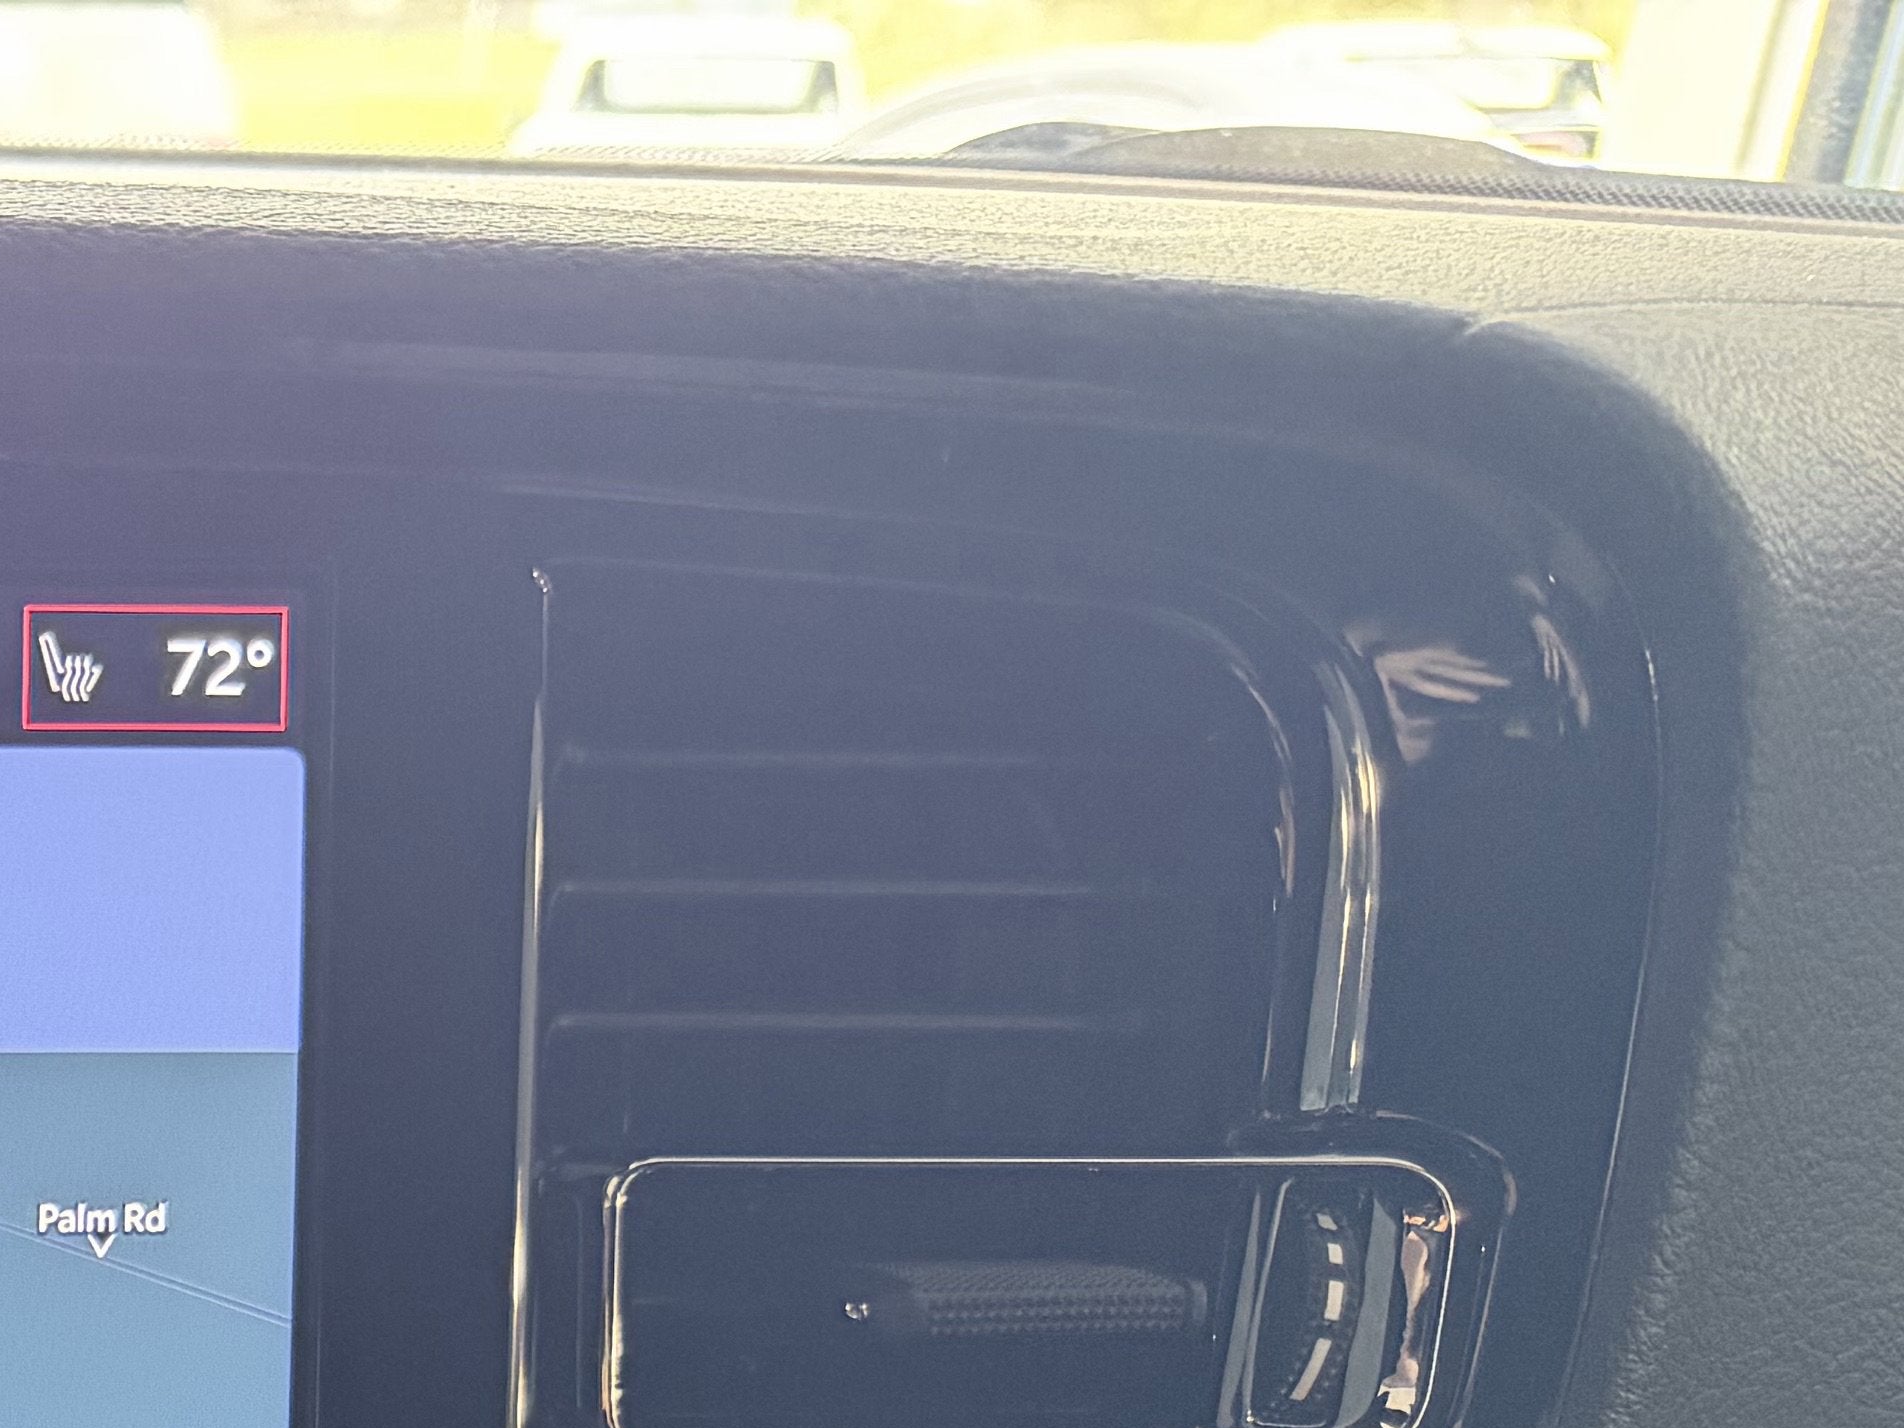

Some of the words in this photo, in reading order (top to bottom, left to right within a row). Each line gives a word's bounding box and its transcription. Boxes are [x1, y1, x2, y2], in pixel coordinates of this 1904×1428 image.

[165, 634, 274, 699] 72°
[36, 1202, 117, 1237] Palm
[121, 1202, 168, 1237] Rd
